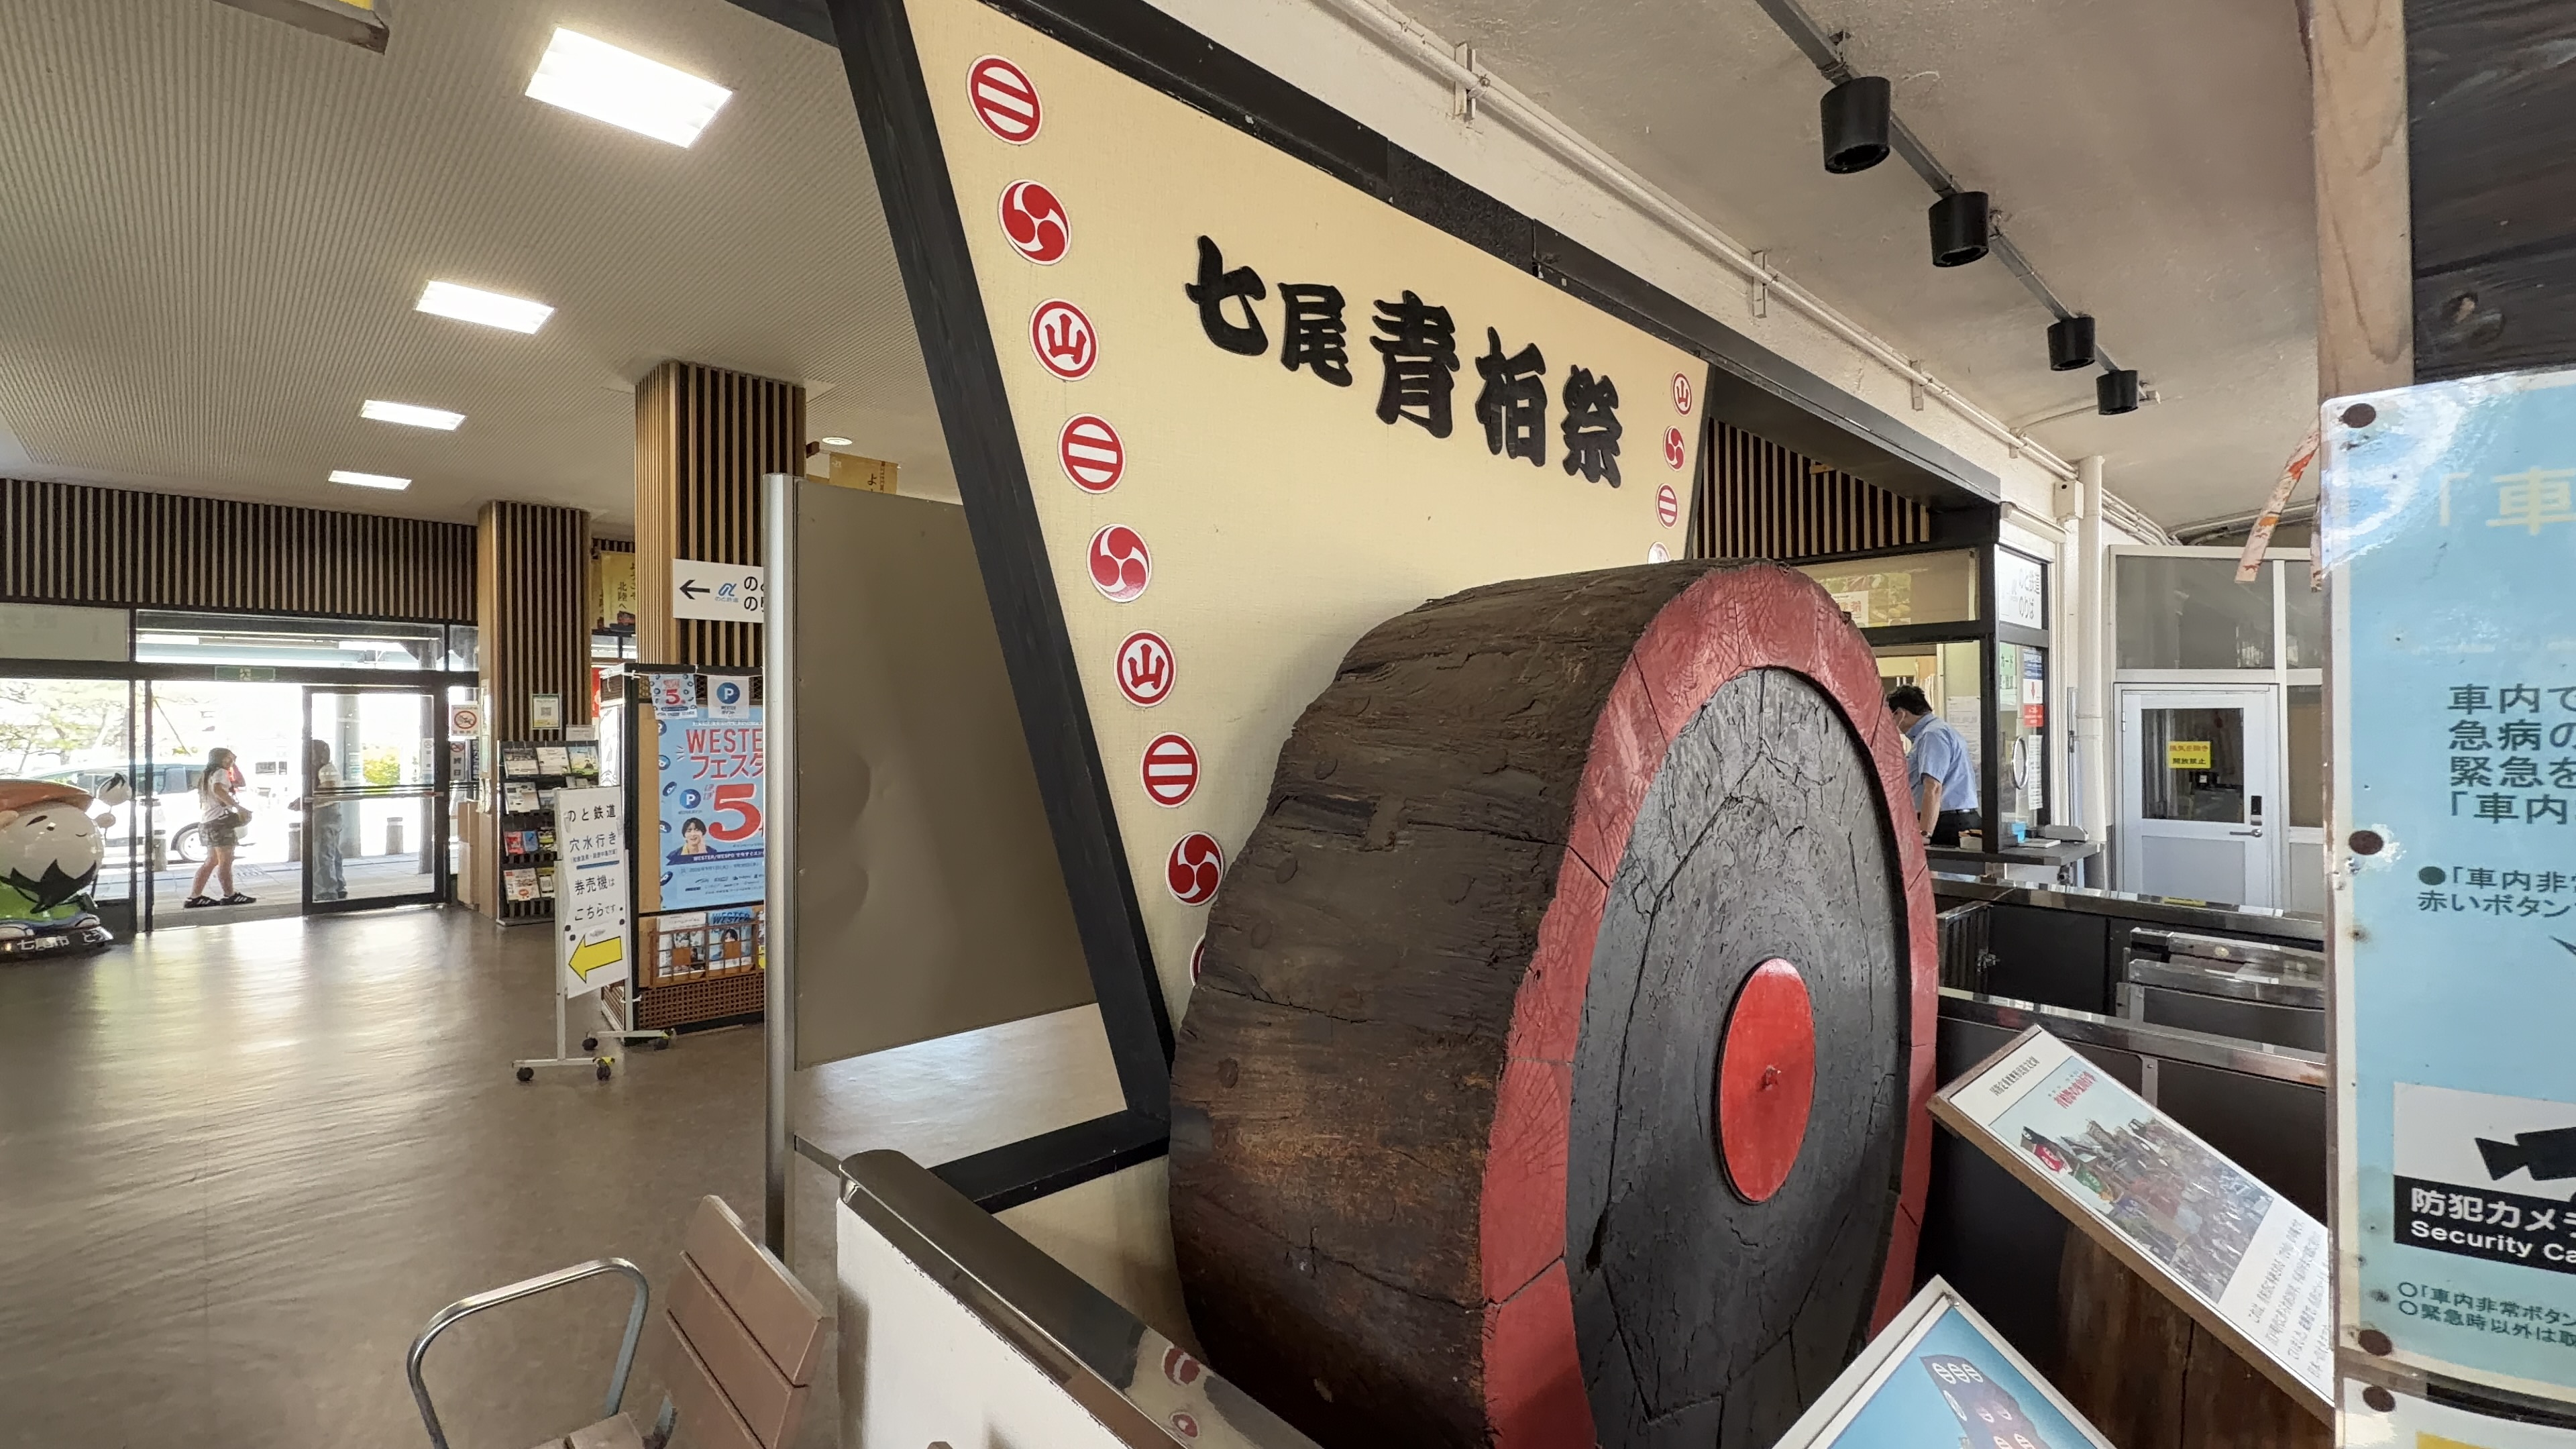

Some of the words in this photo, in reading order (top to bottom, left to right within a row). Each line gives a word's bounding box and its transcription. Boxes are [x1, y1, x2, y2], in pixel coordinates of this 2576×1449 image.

[1185, 235, 1621, 488] 七尾青柏祭
[744, 576, 764, 592] の
[744, 596, 764, 612] の
[568, 804, 616, 822] のと鉄道
[708, 783, 762, 842] 5
[2451, 791, 2576, 825] 「車内
[570, 832, 616, 853] 穴水行き
[575, 875, 615, 896] 券売機は
[2453, 866, 2576, 894] 「車内非
[2417, 890, 2576, 918] 赤いボタン
[2410, 1220, 2533, 1258] Security
